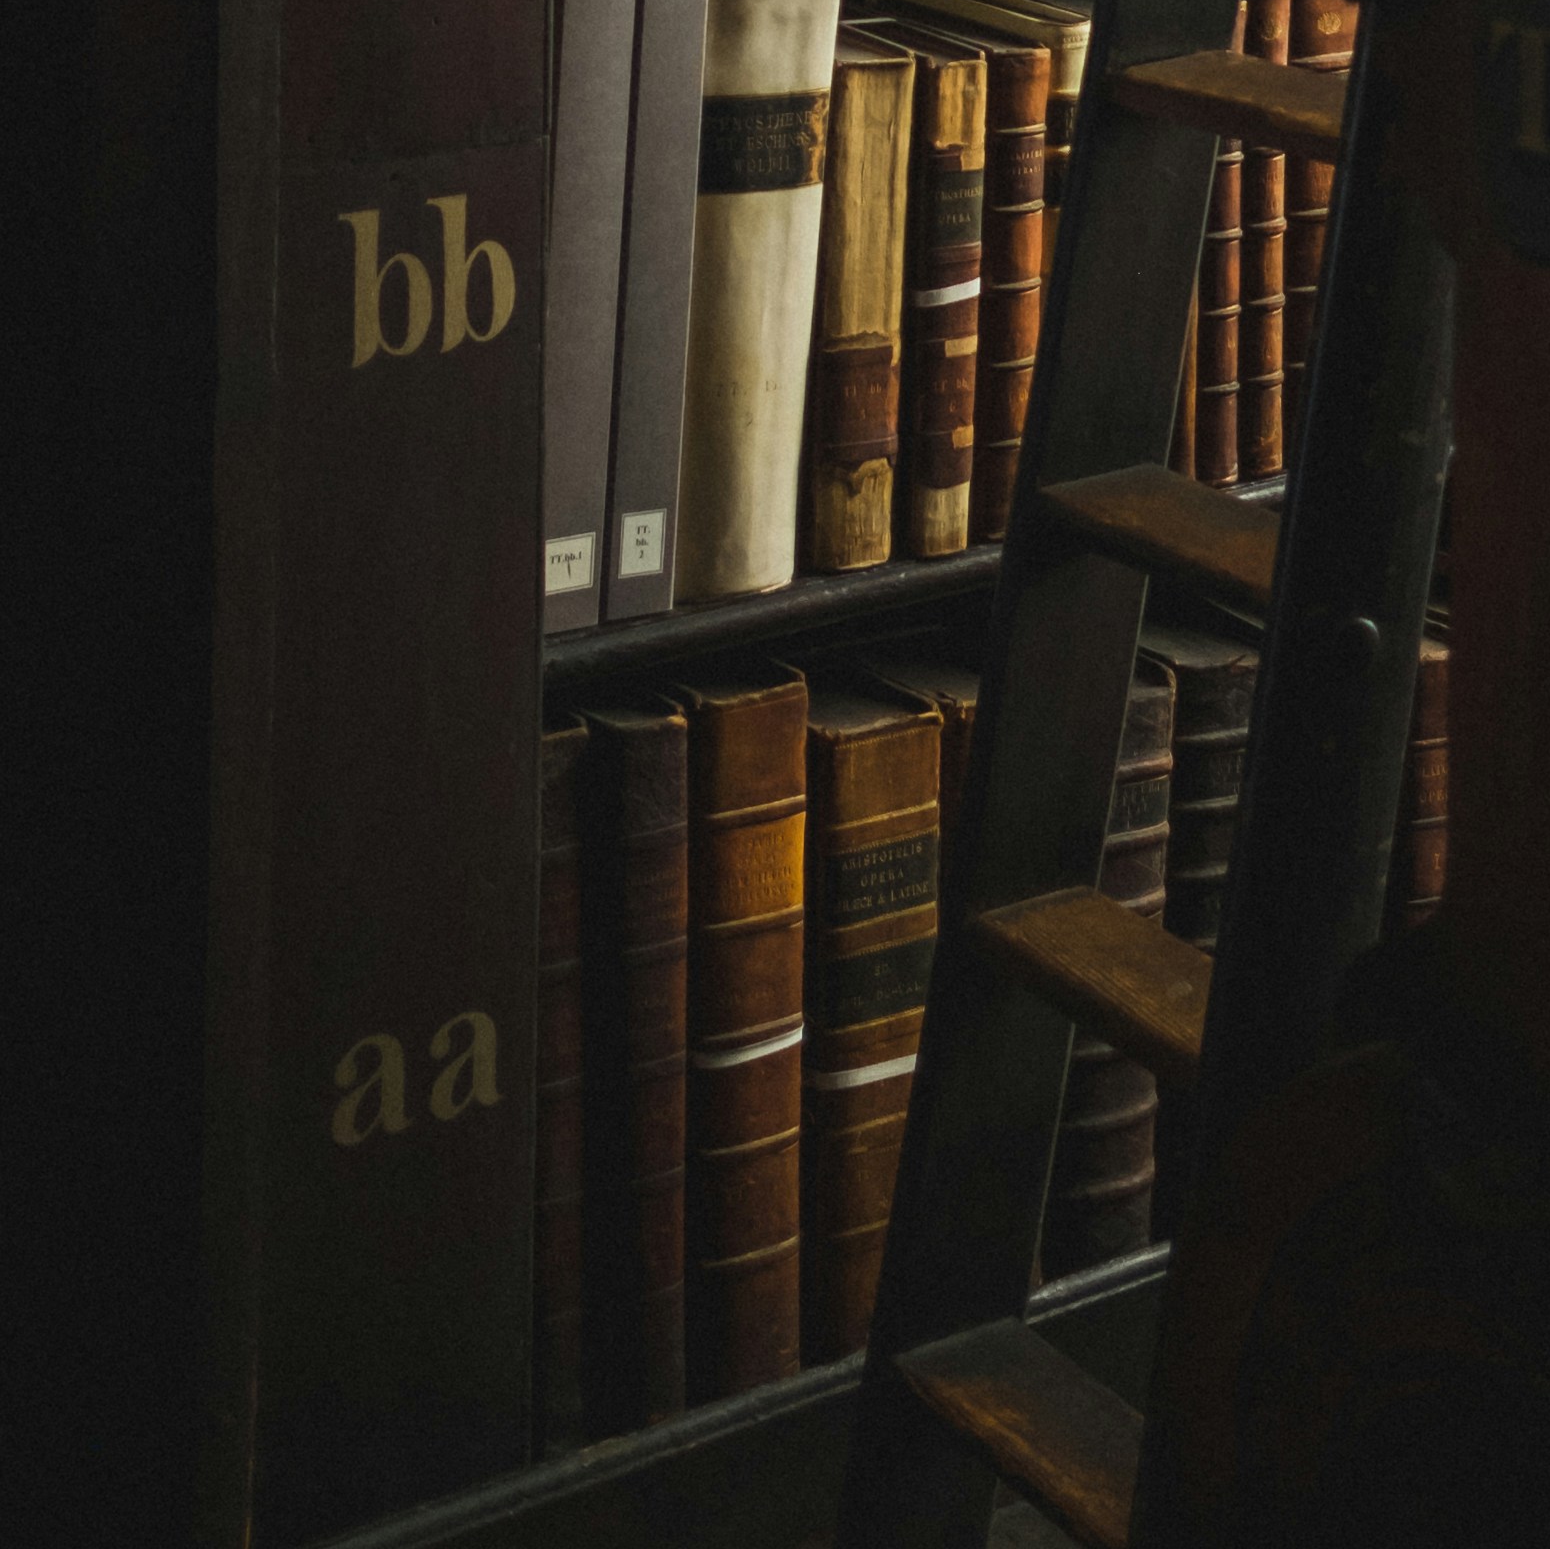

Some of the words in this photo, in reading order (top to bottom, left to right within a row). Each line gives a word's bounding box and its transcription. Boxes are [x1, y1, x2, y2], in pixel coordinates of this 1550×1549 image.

[346, 193, 518, 366] bb
[841, 843, 922, 872] ARISTOTELIS
[860, 867, 904, 887] OPERA
[331, 1010, 503, 1145] aa
